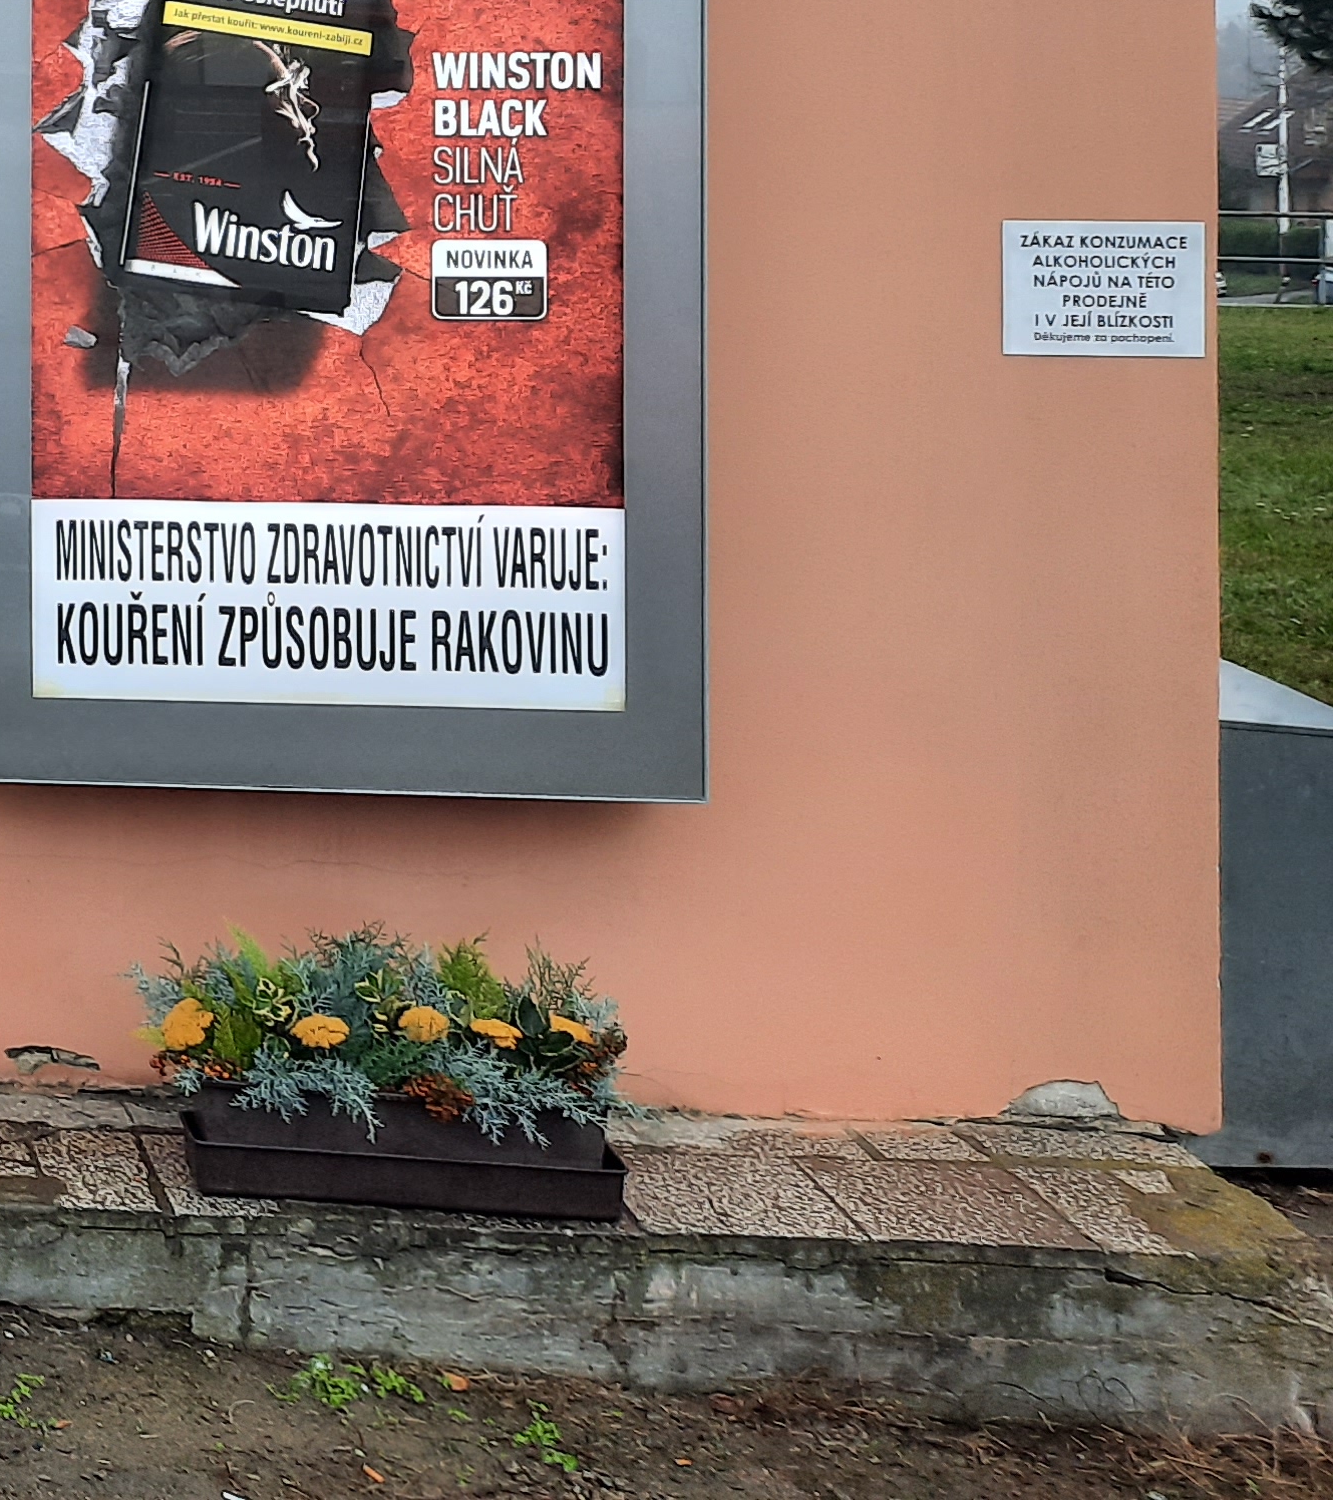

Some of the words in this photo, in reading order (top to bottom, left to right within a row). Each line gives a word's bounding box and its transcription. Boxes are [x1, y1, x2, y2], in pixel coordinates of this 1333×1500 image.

[432, 52, 601, 90] WINSTON
[434, 99, 548, 137] BLACK
[433, 137, 525, 184] SILNÁ
[433, 186, 518, 232] CHUŤ
[193, 201, 336, 272] Winston
[1020, 231, 1074, 249] ZÁKAZ
[1080, 236, 1188, 250] KONZUMACE
[446, 249, 533, 269] NOVINKA
[1032, 252, 1176, 269] ALKOHOLICKÝCH
[454, 279, 514, 316] 126
[515, 280, 533, 295] Kč
[1034, 270, 1102, 288] NÁPOJŮ
[1107, 275, 1131, 288] NA
[1137, 272, 1175, 289] TÉTO
[1062, 293, 1147, 308] PRODEJNĚ
[1045, 314, 1057, 327] V
[1062, 310, 1091, 328] JEJÍ
[1097, 311, 1174, 329] BLÍZKOSTI
[55, 519, 256, 585] MINISTERSTVO
[267, 514, 485, 588] ZDRAVOTNICTVÍ
[493, 526, 609, 591] VARUJE:
[57, 591, 207, 666] KOUŘENÍ
[218, 591, 417, 672] ZPŮSOBUJE
[432, 610, 609, 677] RAKOVINU
